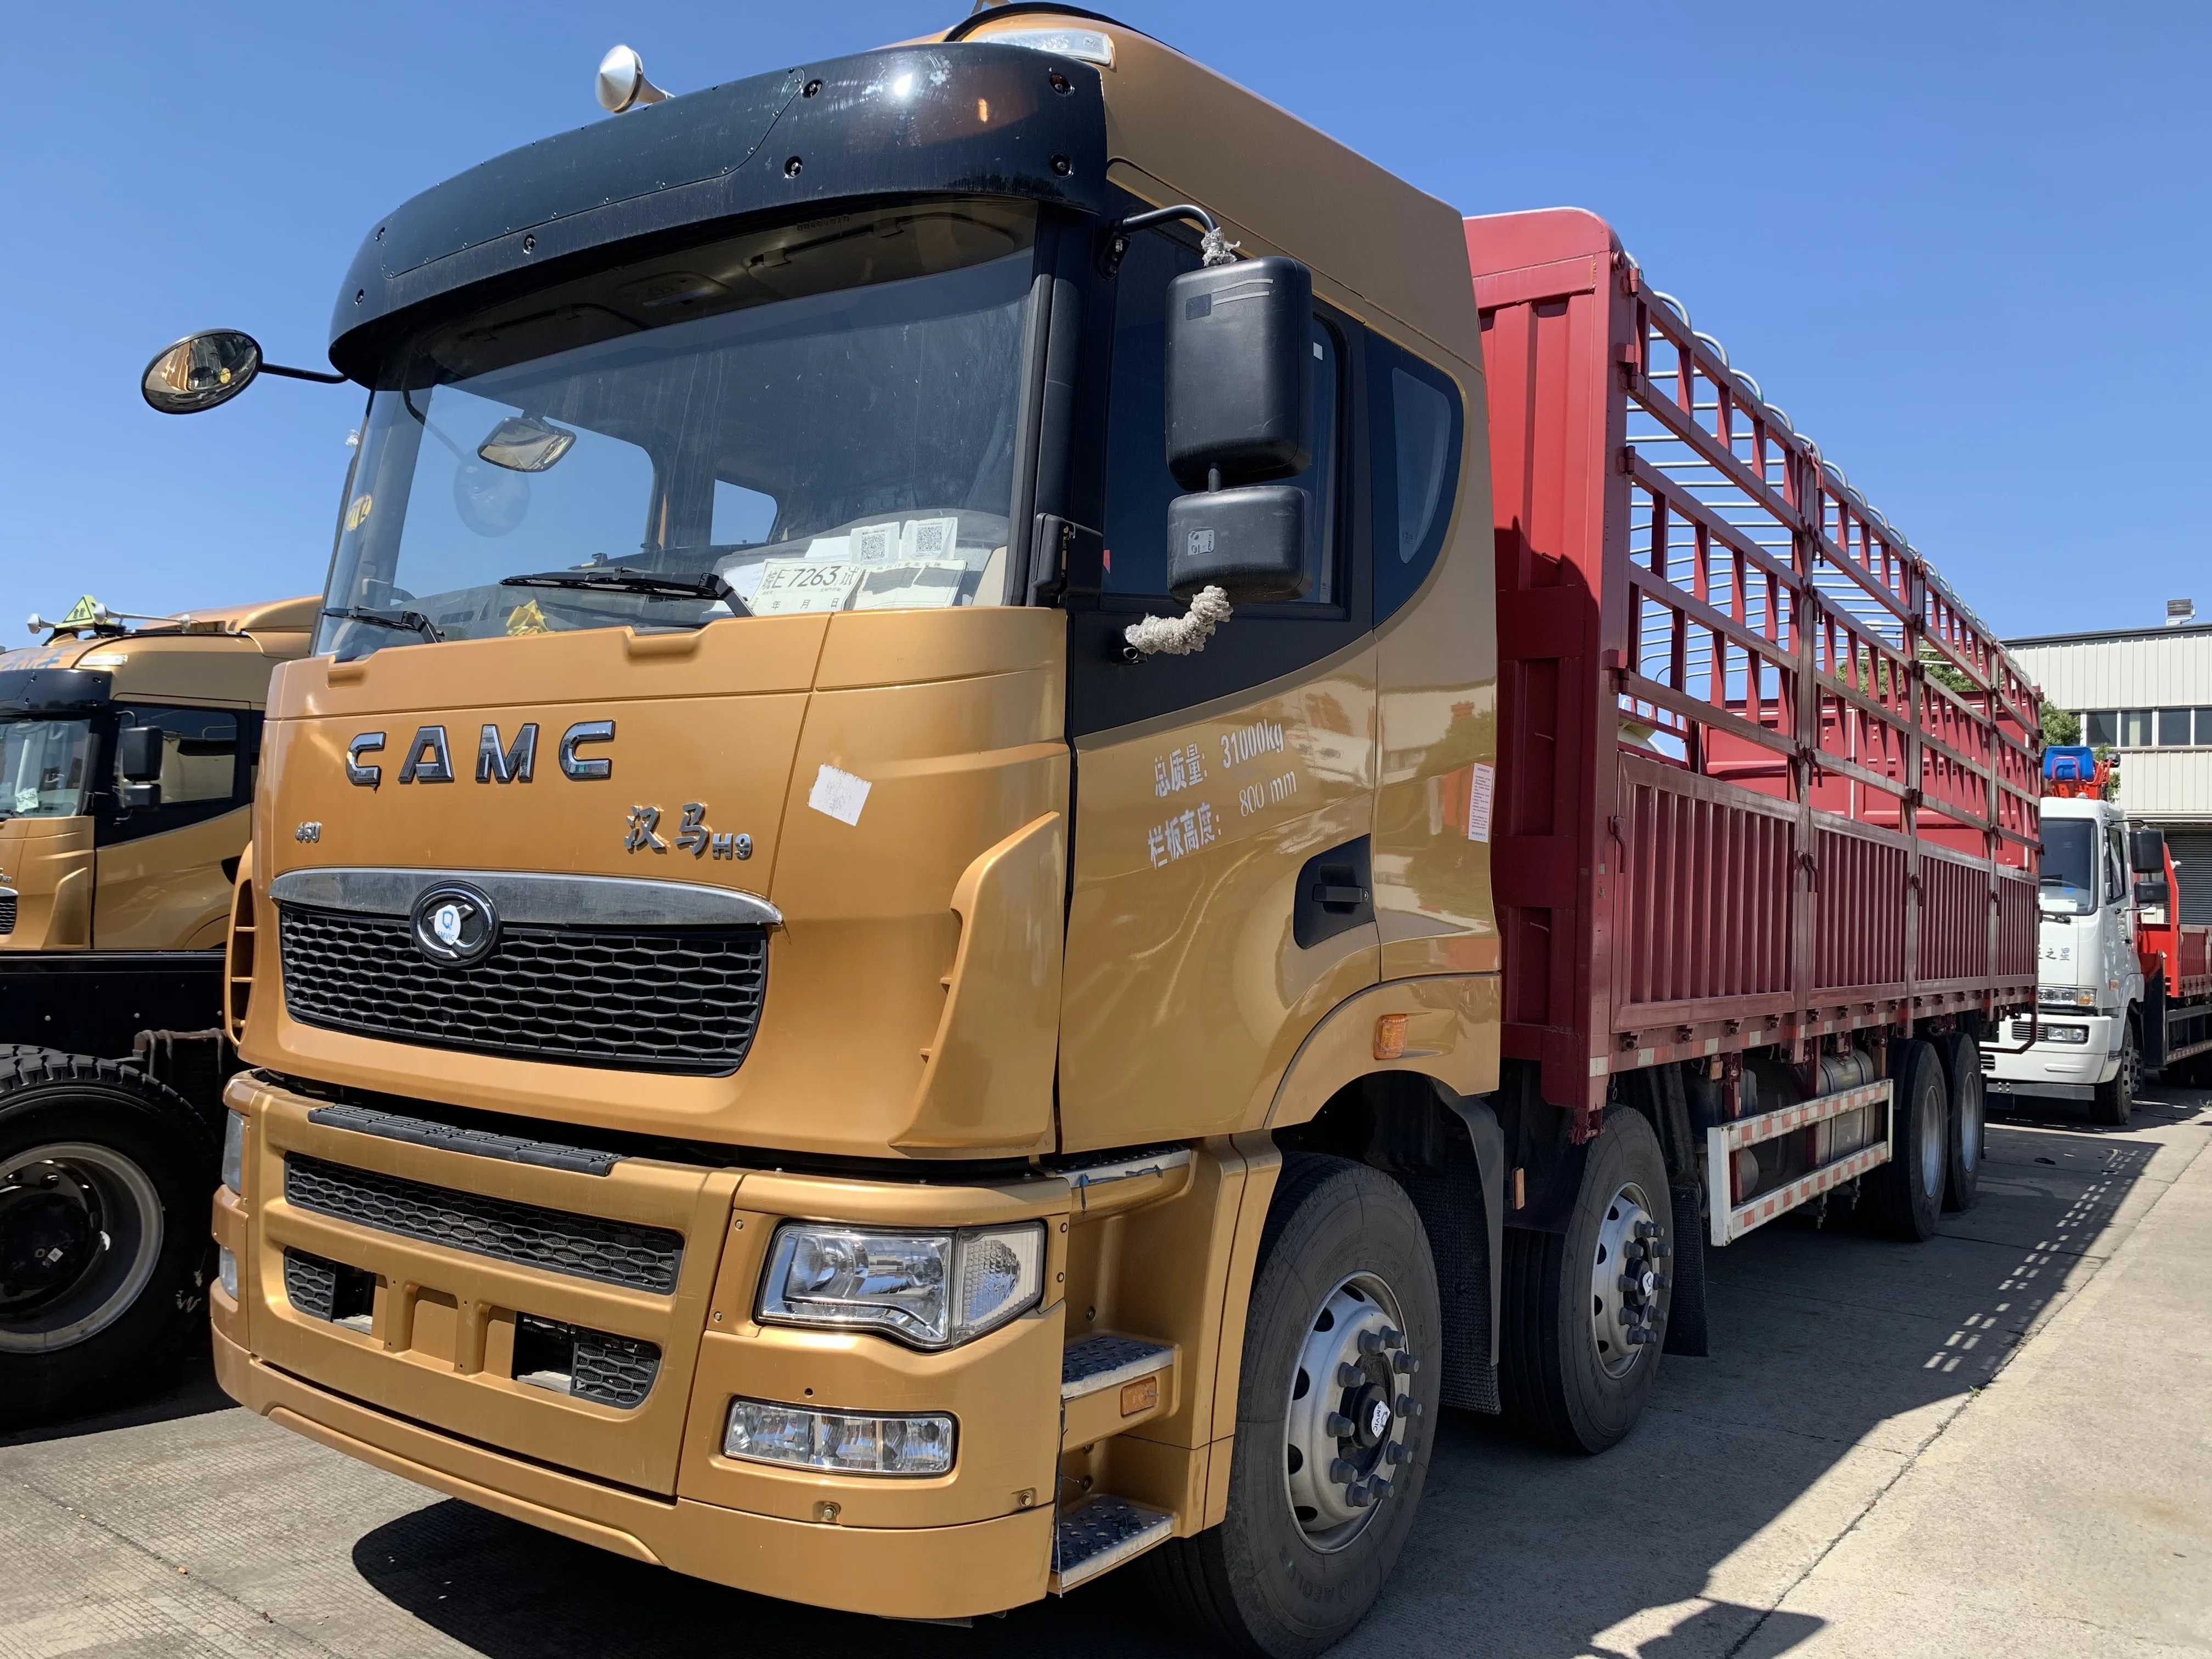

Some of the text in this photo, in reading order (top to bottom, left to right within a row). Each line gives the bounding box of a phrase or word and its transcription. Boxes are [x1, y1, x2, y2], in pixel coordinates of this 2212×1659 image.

[771, 597, 839, 610] 年 月 日
[346, 719, 616, 785] CAMC
[1221, 718, 1284, 769] 31000kg
[1239, 782, 1265, 817] 800
[623, 803, 753, 861] 汉马 H9
[437, 930, 455, 942] SMVIC
[2038, 947, 2070, 961] 之星
[1373, 1404, 1382, 1432] SMVIC
